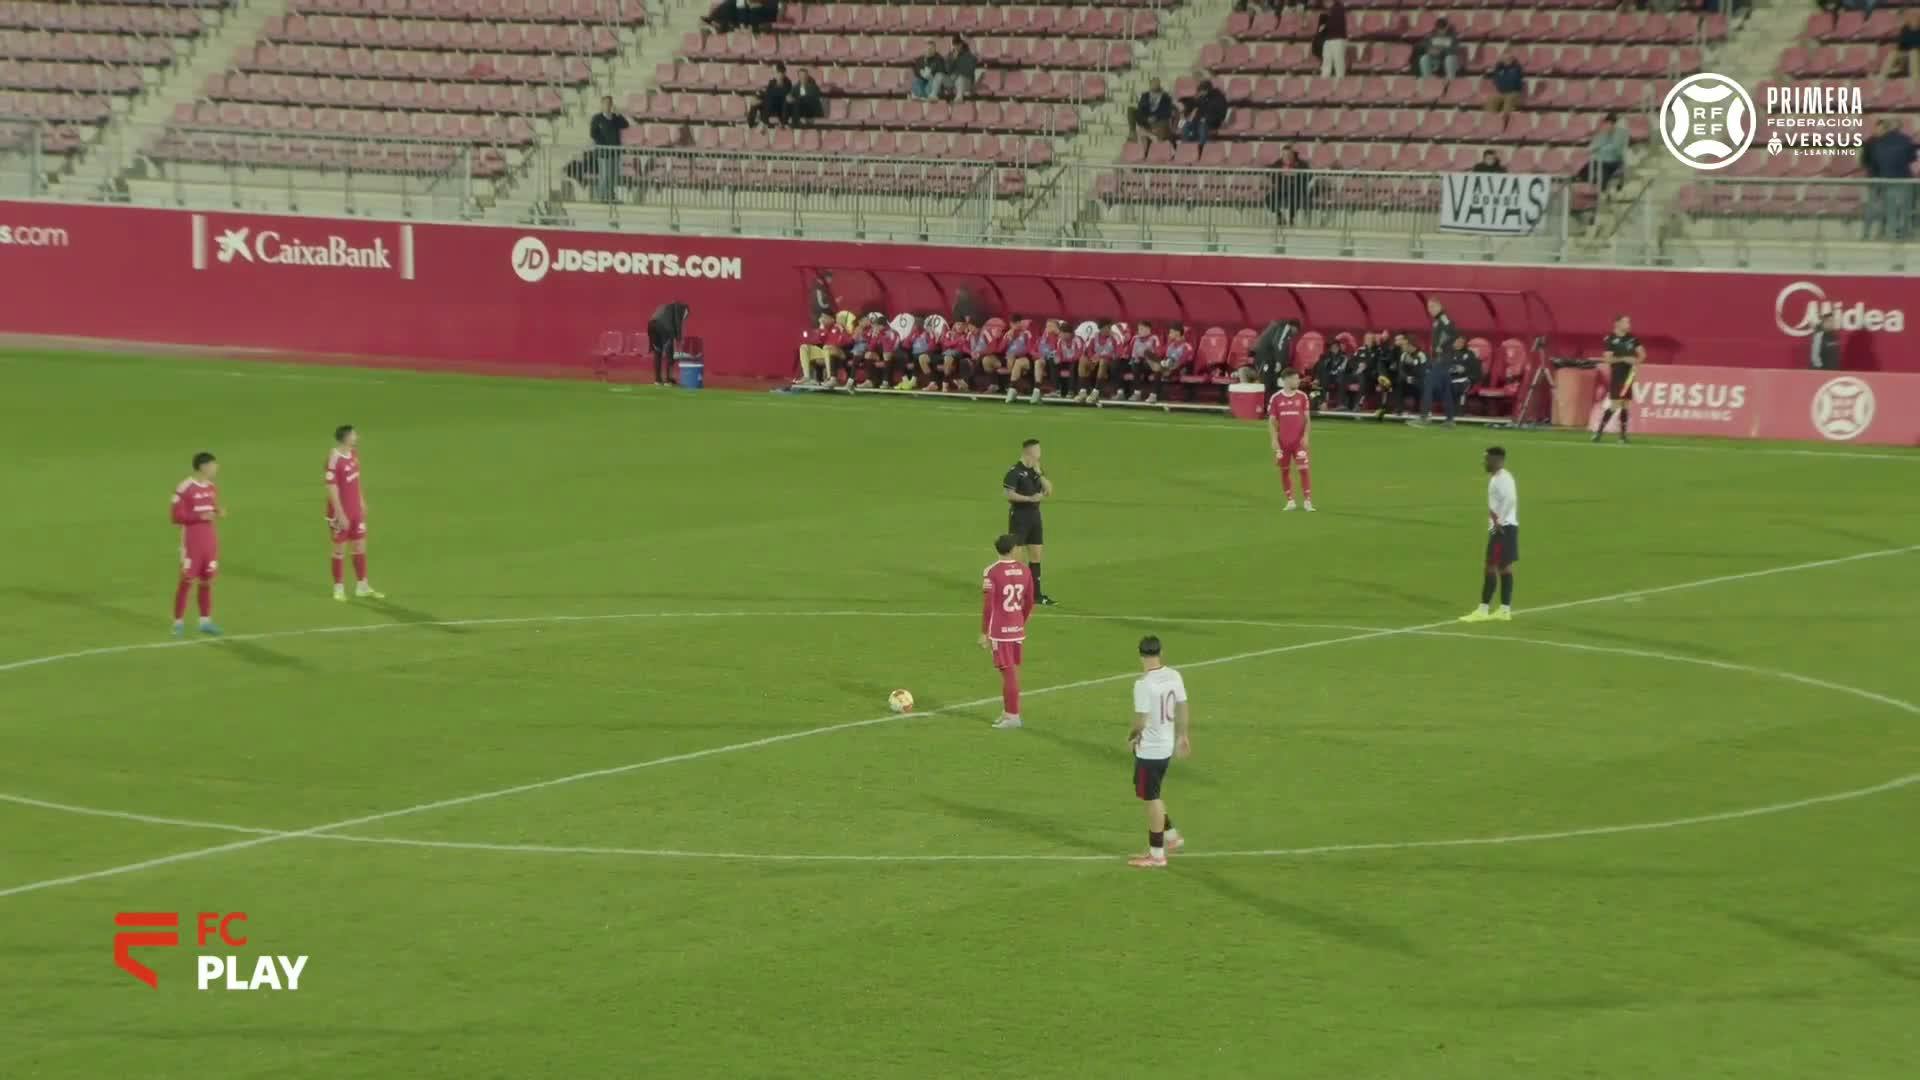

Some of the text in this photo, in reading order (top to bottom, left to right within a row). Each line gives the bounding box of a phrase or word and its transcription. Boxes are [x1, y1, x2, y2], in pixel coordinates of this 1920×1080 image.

[255, 231, 391, 268] CaixaBank
[518, 248, 543, 270] JD
[552, 249, 741, 279] JDSPORTS.COM
[1632, 381, 1746, 408] VERSUS
[1002, 584, 1025, 612] 23
[1160, 690, 1177, 725] 10
